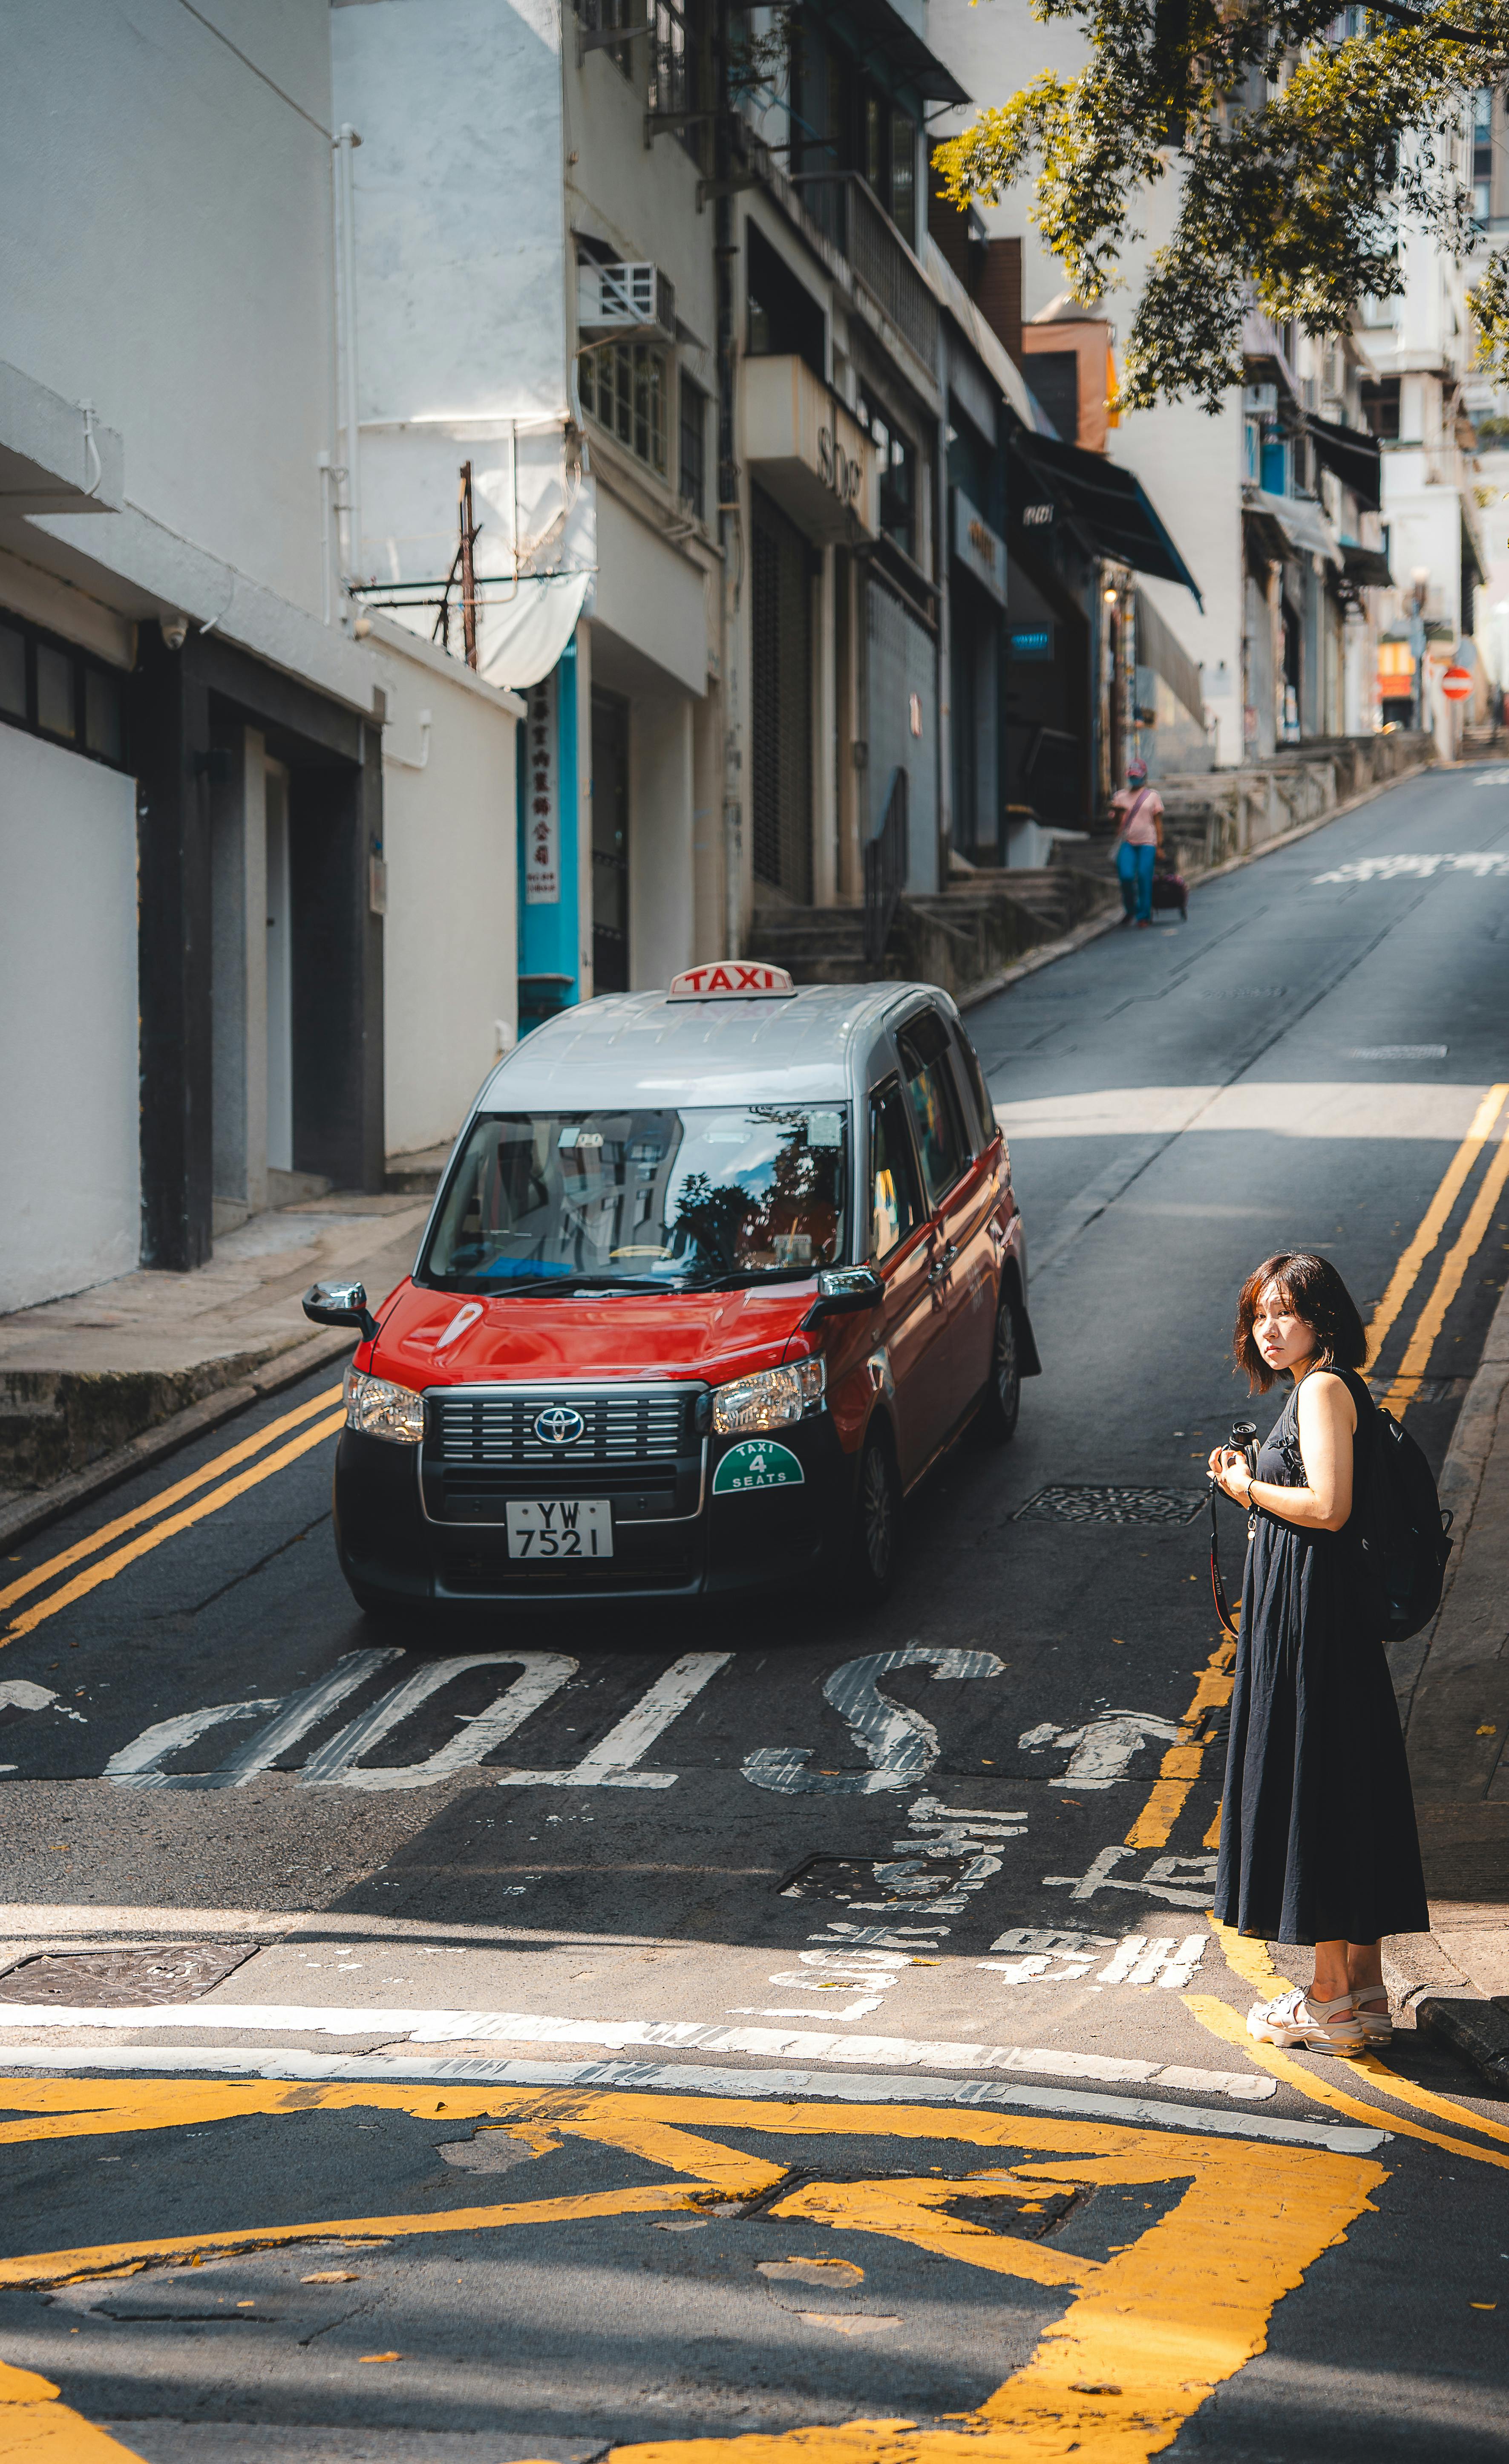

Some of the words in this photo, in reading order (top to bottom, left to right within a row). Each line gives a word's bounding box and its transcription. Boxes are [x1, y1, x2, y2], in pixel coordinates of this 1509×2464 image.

[685, 966, 775, 992] TAXI
[735, 1443, 774, 1457] TAXI
[749, 1455, 767, 1473] 4
[732, 1473, 786, 1487] SEATS
[537, 1502, 579, 1529] YW
[516, 1529, 598, 1556] 7521
[104, 1647, 1009, 1794] STOP
[726, 1922, 951, 2022] LOOK
[847, 1796, 1028, 1914] RIGHT
